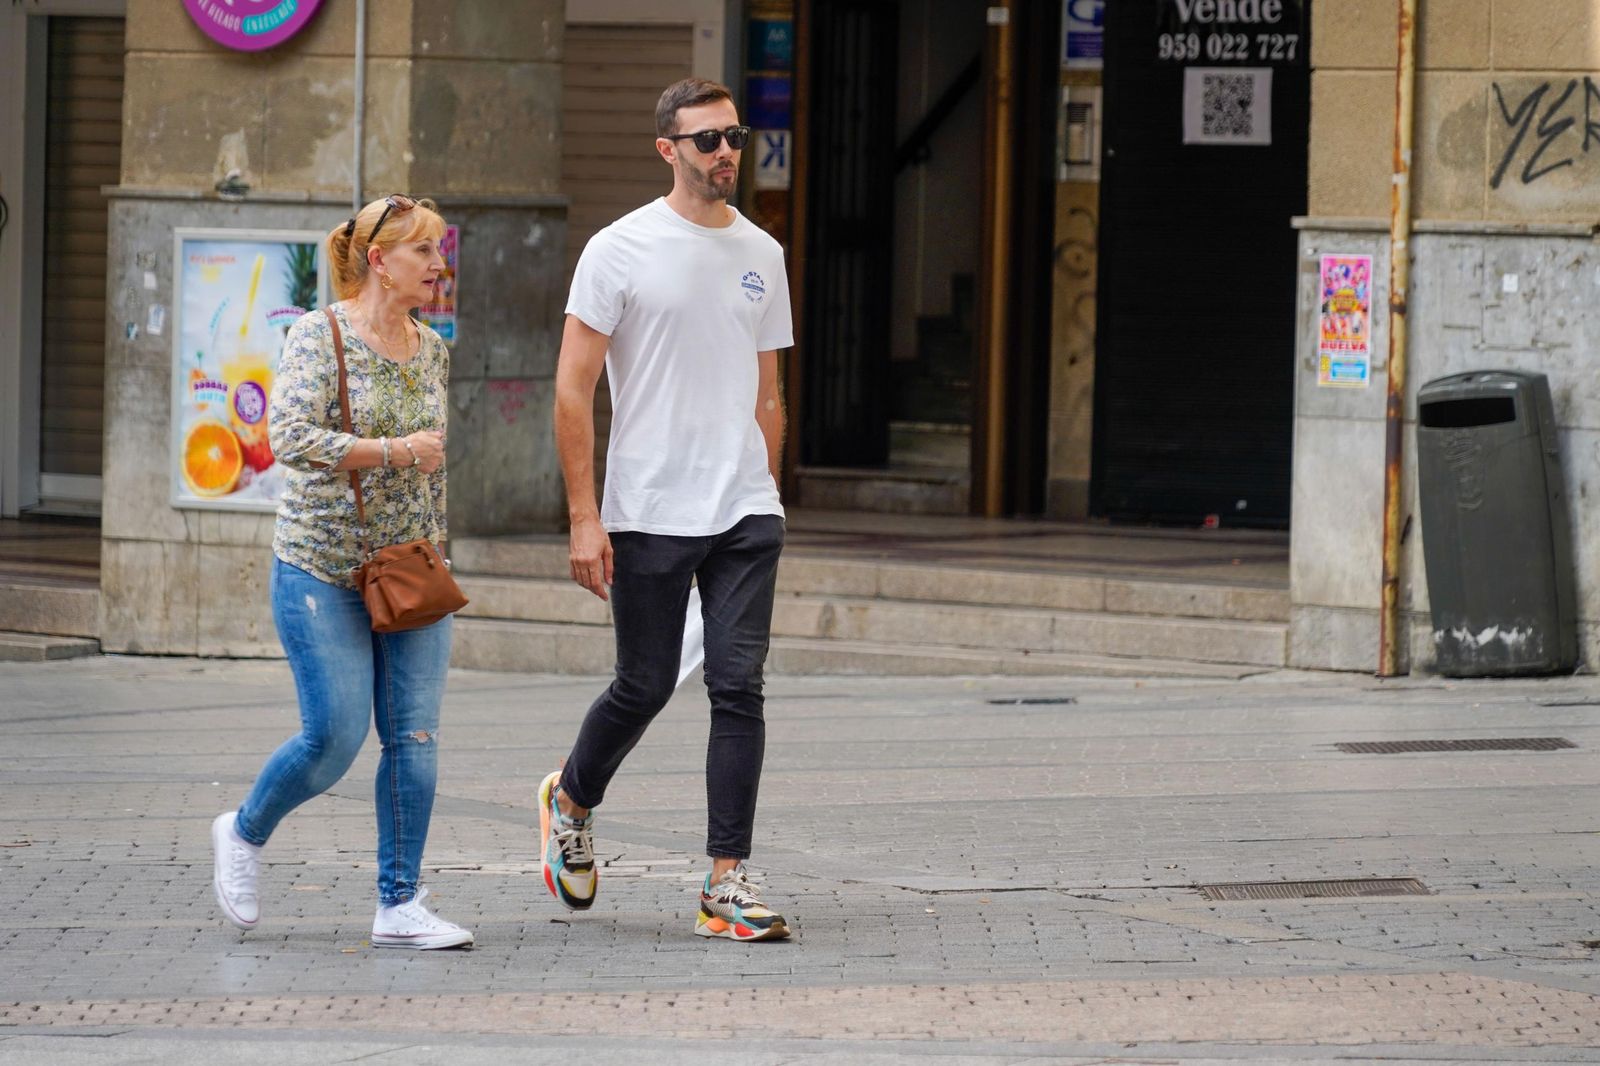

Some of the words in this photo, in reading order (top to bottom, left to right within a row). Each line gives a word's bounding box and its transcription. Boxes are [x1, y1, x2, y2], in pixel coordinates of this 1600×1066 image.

[1175, 0, 1283, 24] Vende
[1158, 33, 1200, 60] 959
[1206, 33, 1249, 60] 022
[1256, 34, 1299, 60] 727
